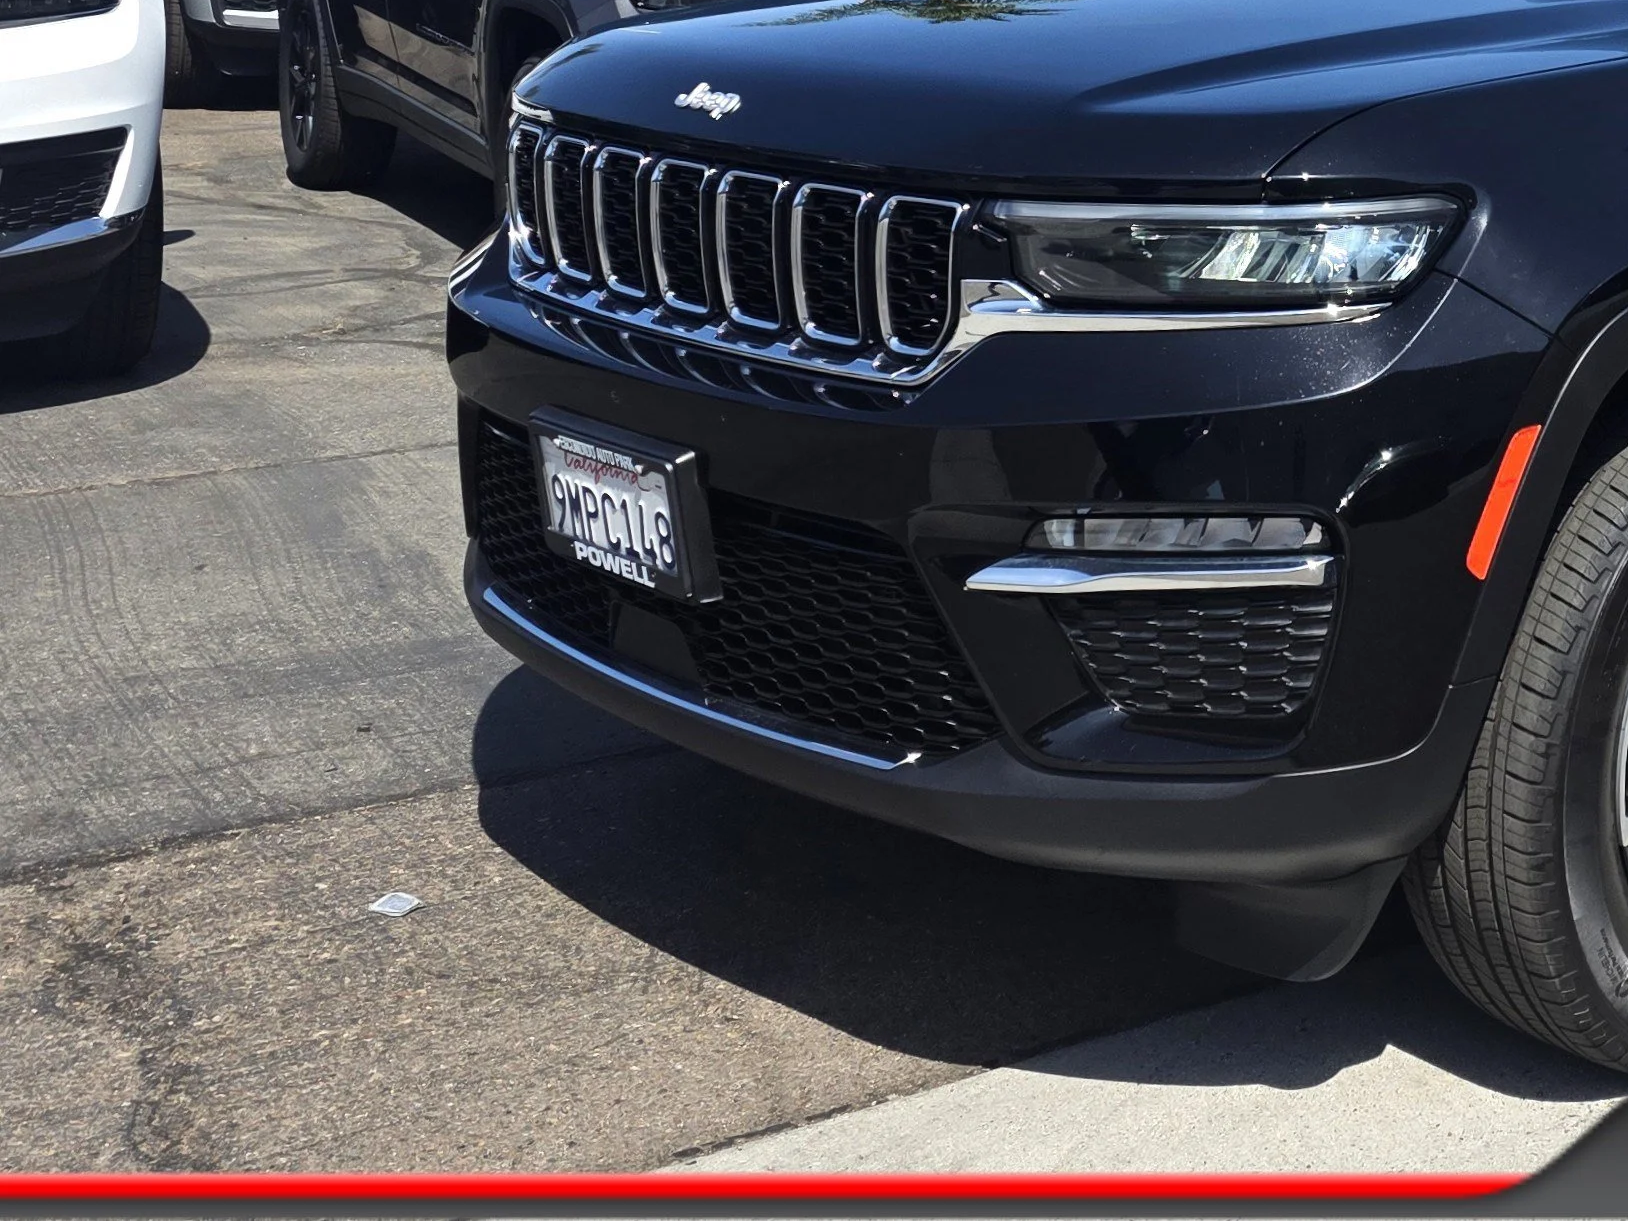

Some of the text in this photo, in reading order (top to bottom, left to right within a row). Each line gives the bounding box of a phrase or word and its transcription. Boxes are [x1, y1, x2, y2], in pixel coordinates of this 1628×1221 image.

[674, 82, 741, 120] Jeep
[551, 473, 677, 570] 9MPC148
[573, 540, 656, 589] POWELL
